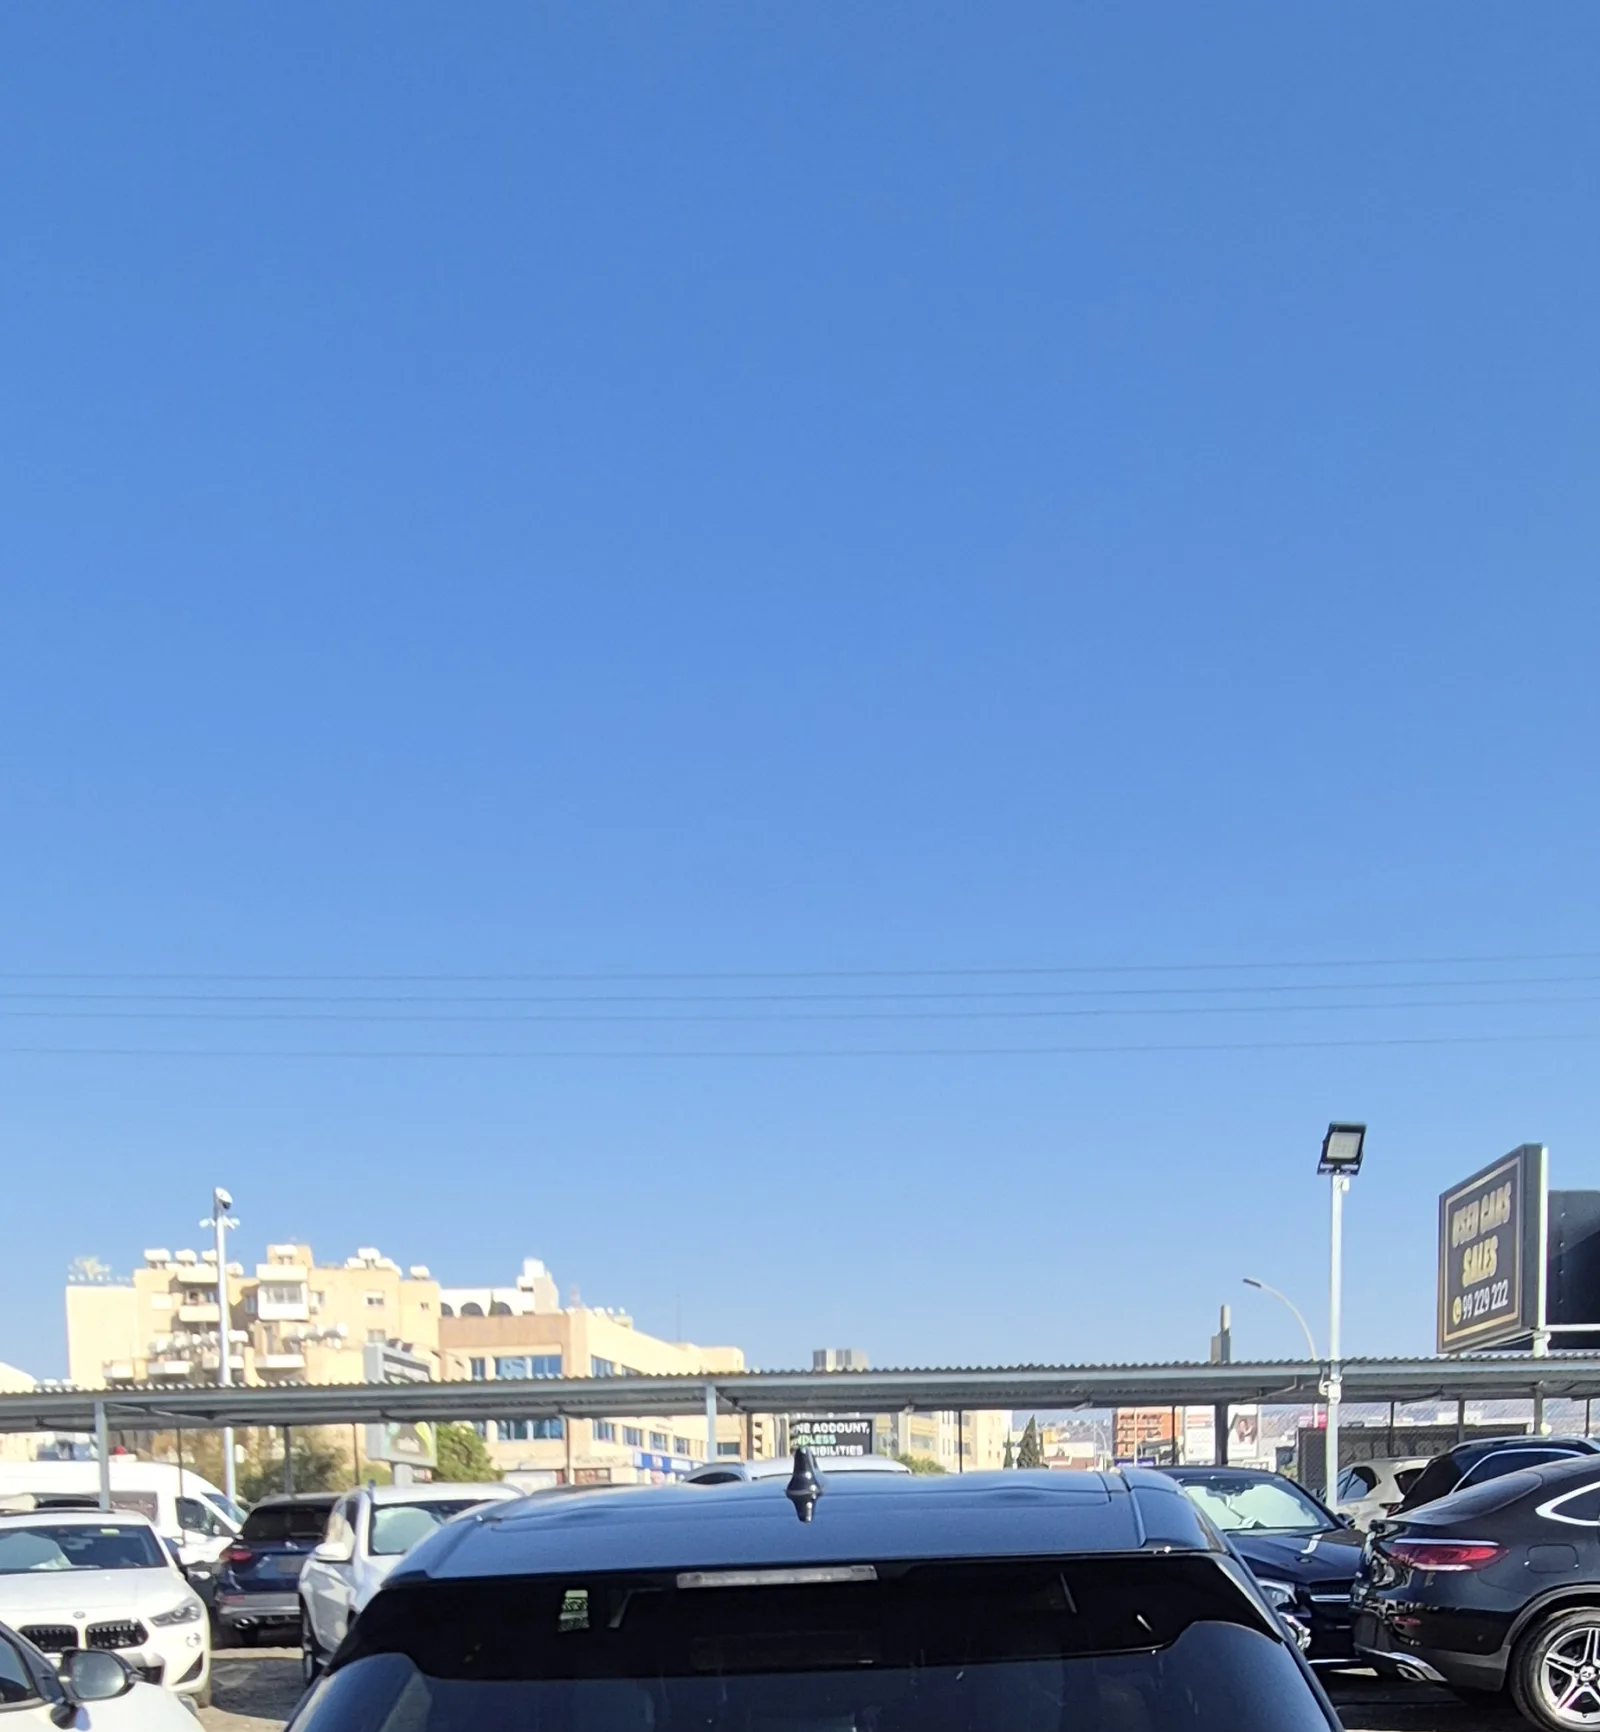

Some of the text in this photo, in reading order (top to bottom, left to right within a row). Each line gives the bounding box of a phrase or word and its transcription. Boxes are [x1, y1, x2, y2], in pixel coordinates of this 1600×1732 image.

[1452, 1180, 1512, 1249] USED CARS
[1462, 1235, 1499, 1289] SALES
[1462, 1278, 1509, 1321] 99 229 222
[812, 1422, 870, 1434] ACCOUNT,
